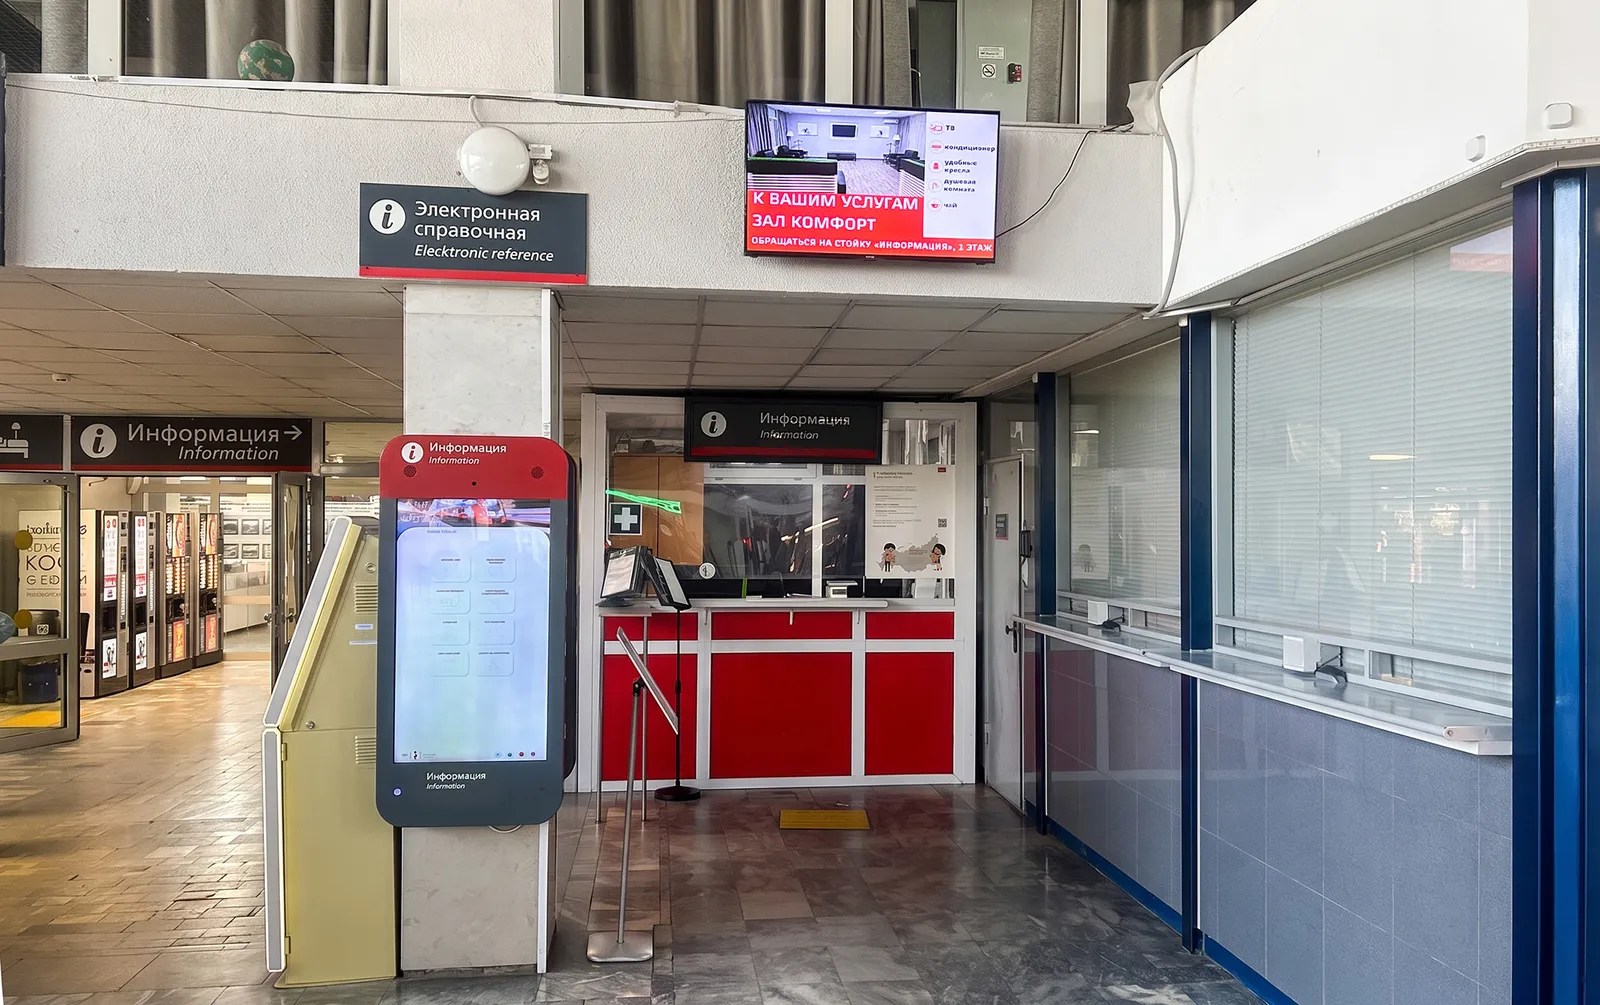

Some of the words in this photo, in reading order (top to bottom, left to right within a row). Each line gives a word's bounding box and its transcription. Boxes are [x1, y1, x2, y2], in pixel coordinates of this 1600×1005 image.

[944, 144, 996, 152] кондиционер
[944, 158, 977, 166] удобные
[753, 193, 764, 204] К
[769, 193, 836, 208] ВАШИМ
[841, 196, 918, 210] УСЛУГАМ
[414, 200, 541, 222] Электронная
[752, 214, 785, 227] ЗАЛ
[791, 216, 877, 231] КОМФОРТ
[414, 222, 527, 241] справочная
[751, 236, 817, 246] ОБРАЩАТЬСЯ
[819, 238, 833, 247] НА
[834, 238, 872, 249] СТОЙКУ
[874, 241, 957, 252] «ИНФОРМАЦИЯ»,
[958, 243, 964, 251] 1
[966, 243, 993, 253] ЭТАЖ
[414, 244, 489, 260] Elecktronic
[491, 248, 554, 262] reference
[759, 412, 851, 428] Информация
[127, 423, 280, 446] Информация
[759, 429, 820, 440] Information
[178, 445, 279, 461] Information
[429, 442, 507, 454] Информация
[428, 456, 480, 465] Information
[426, 772, 486, 781] Информация
